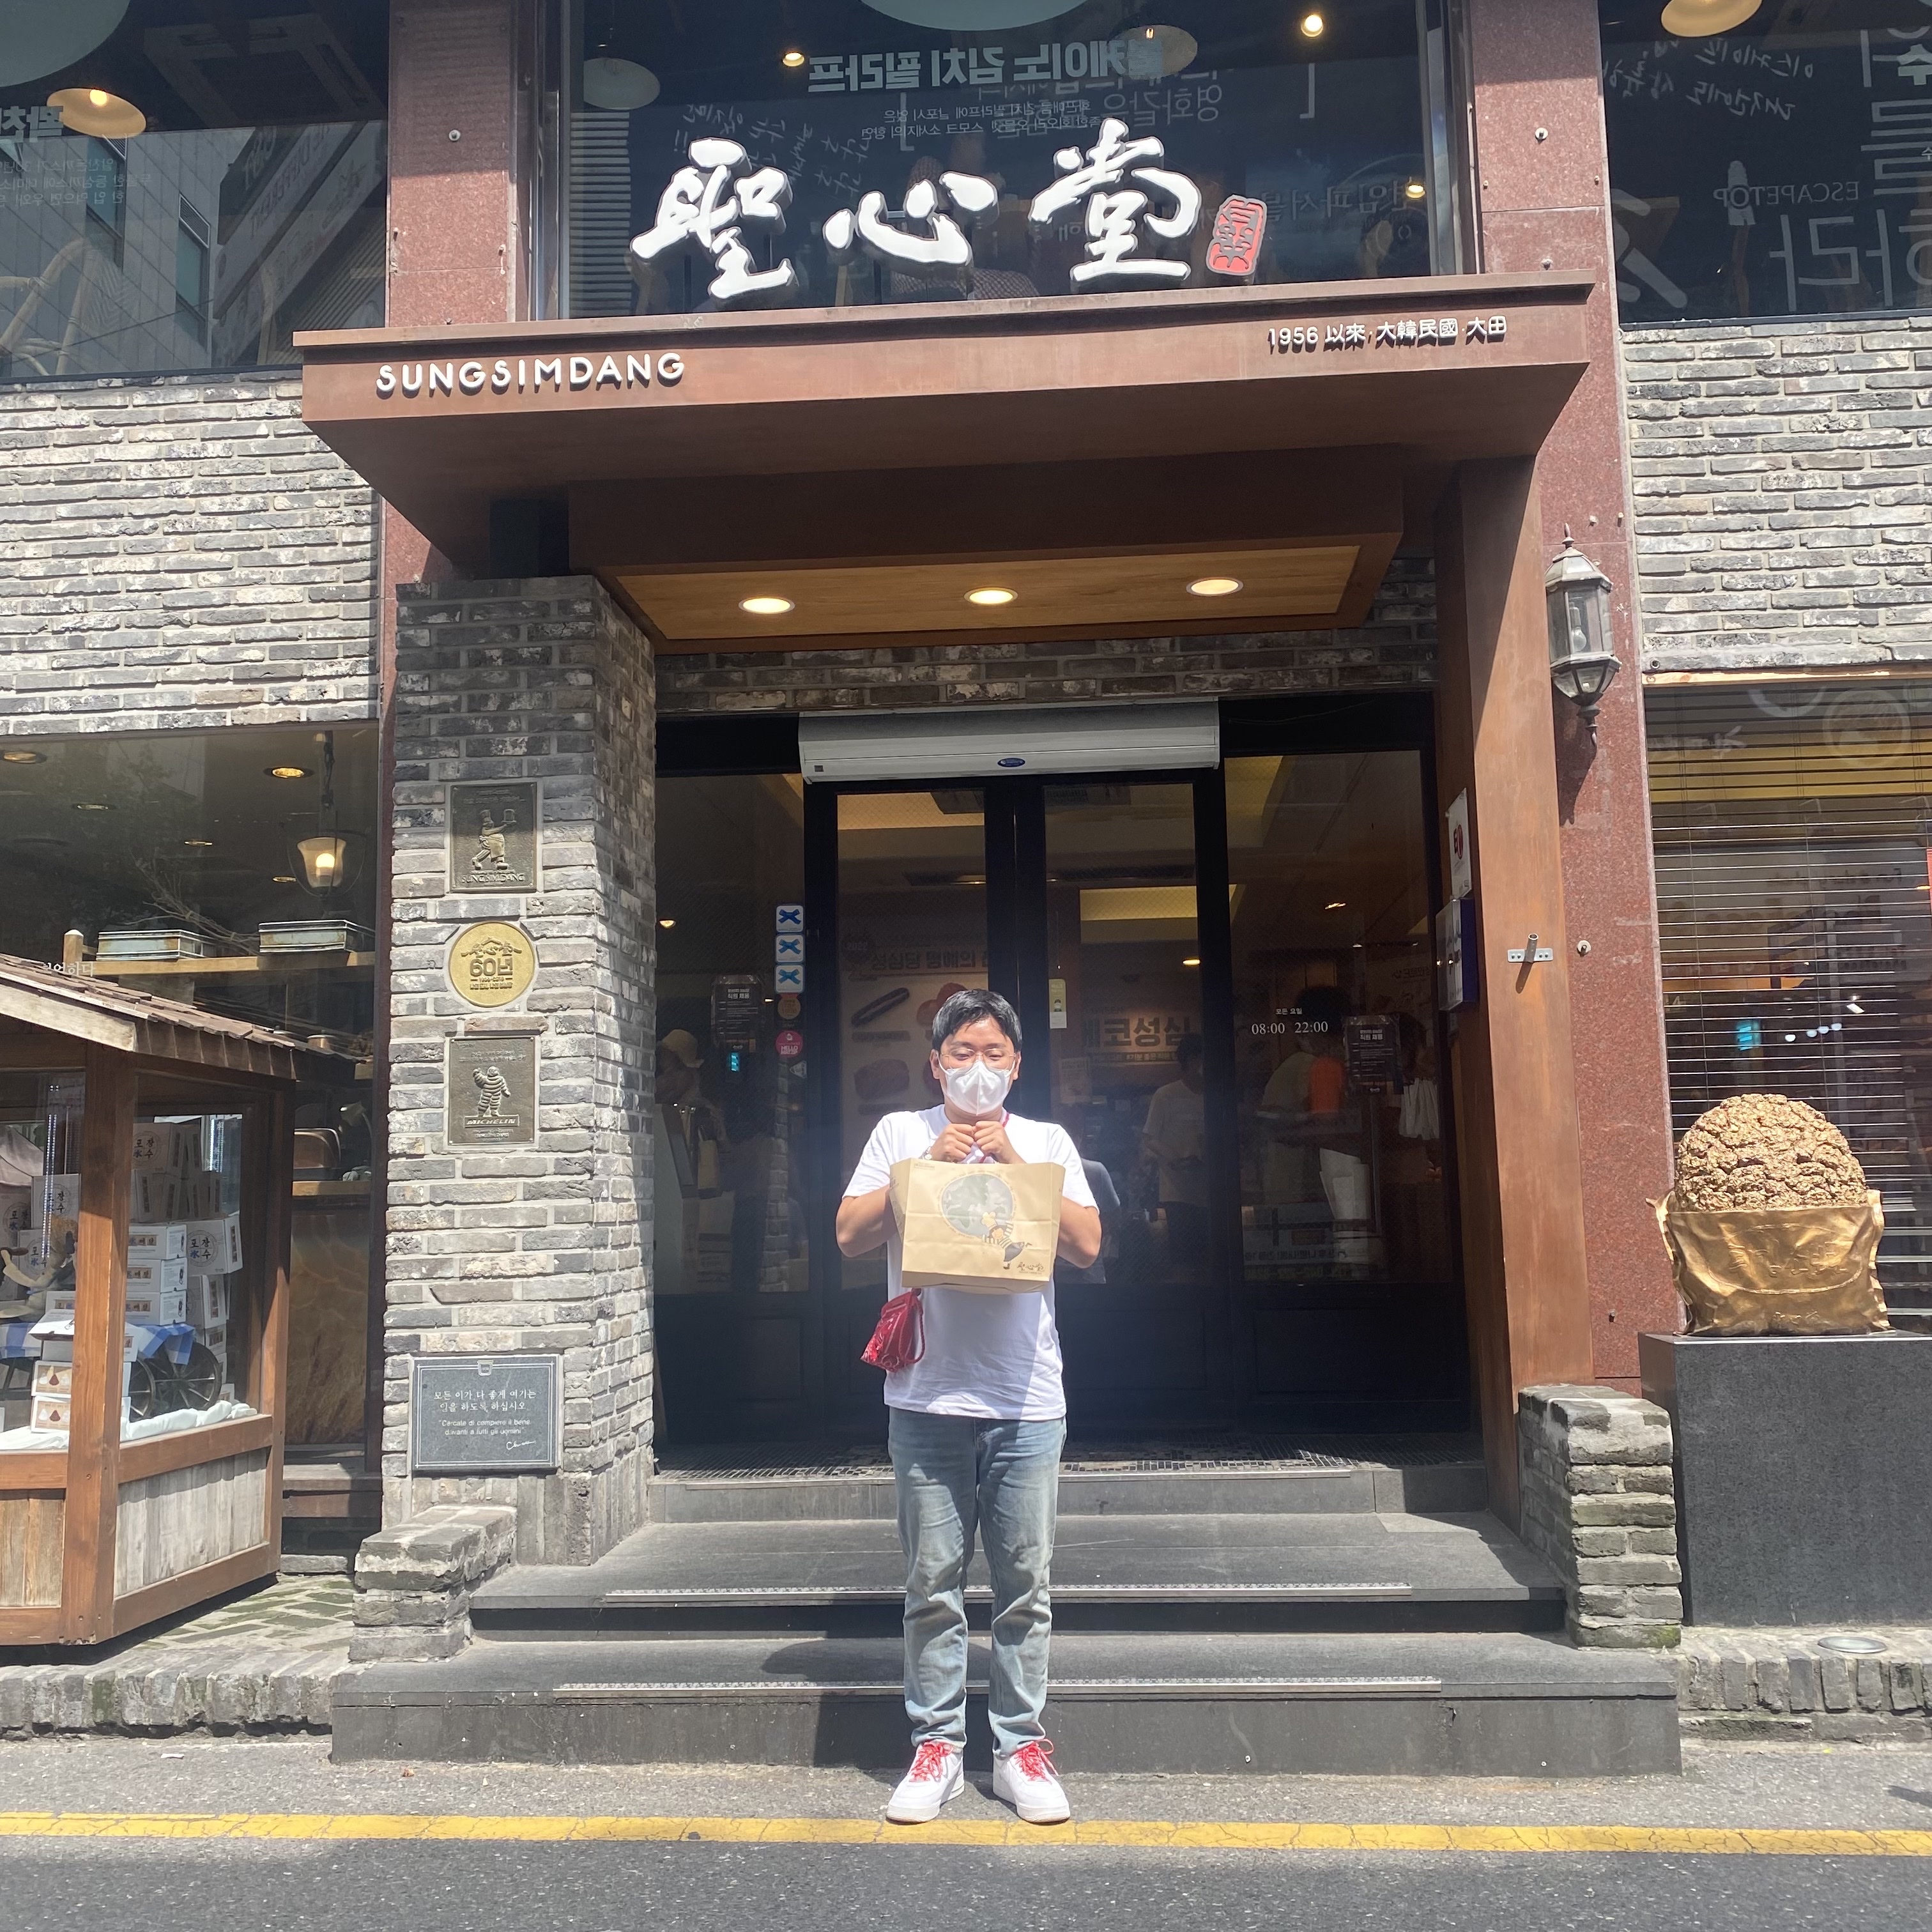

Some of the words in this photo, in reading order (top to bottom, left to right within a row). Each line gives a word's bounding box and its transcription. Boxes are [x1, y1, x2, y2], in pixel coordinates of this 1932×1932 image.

[631, 118, 1200, 298] 聖心堂
[1269, 328, 1319, 346] 1956
[1377, 318, 1459, 341] 大韓民國
[1468, 316, 1507, 336] 大田
[376, 353, 686, 392] SUNGSIMDANG
[461, 873, 525, 883] SUNGSIMDANG
[470, 957, 513, 977] 60년
[1251, 1022, 1285, 1035] 08:00
[1294, 1021, 1328, 1033] 22:00
[434, 1390, 451, 1400] 모든
[455, 1389, 473, 1400] 이가
[477, 1390, 485, 1400] 다
[488, 1389, 506, 1400] 좋게
[510, 1388, 537, 1400] 여기는
